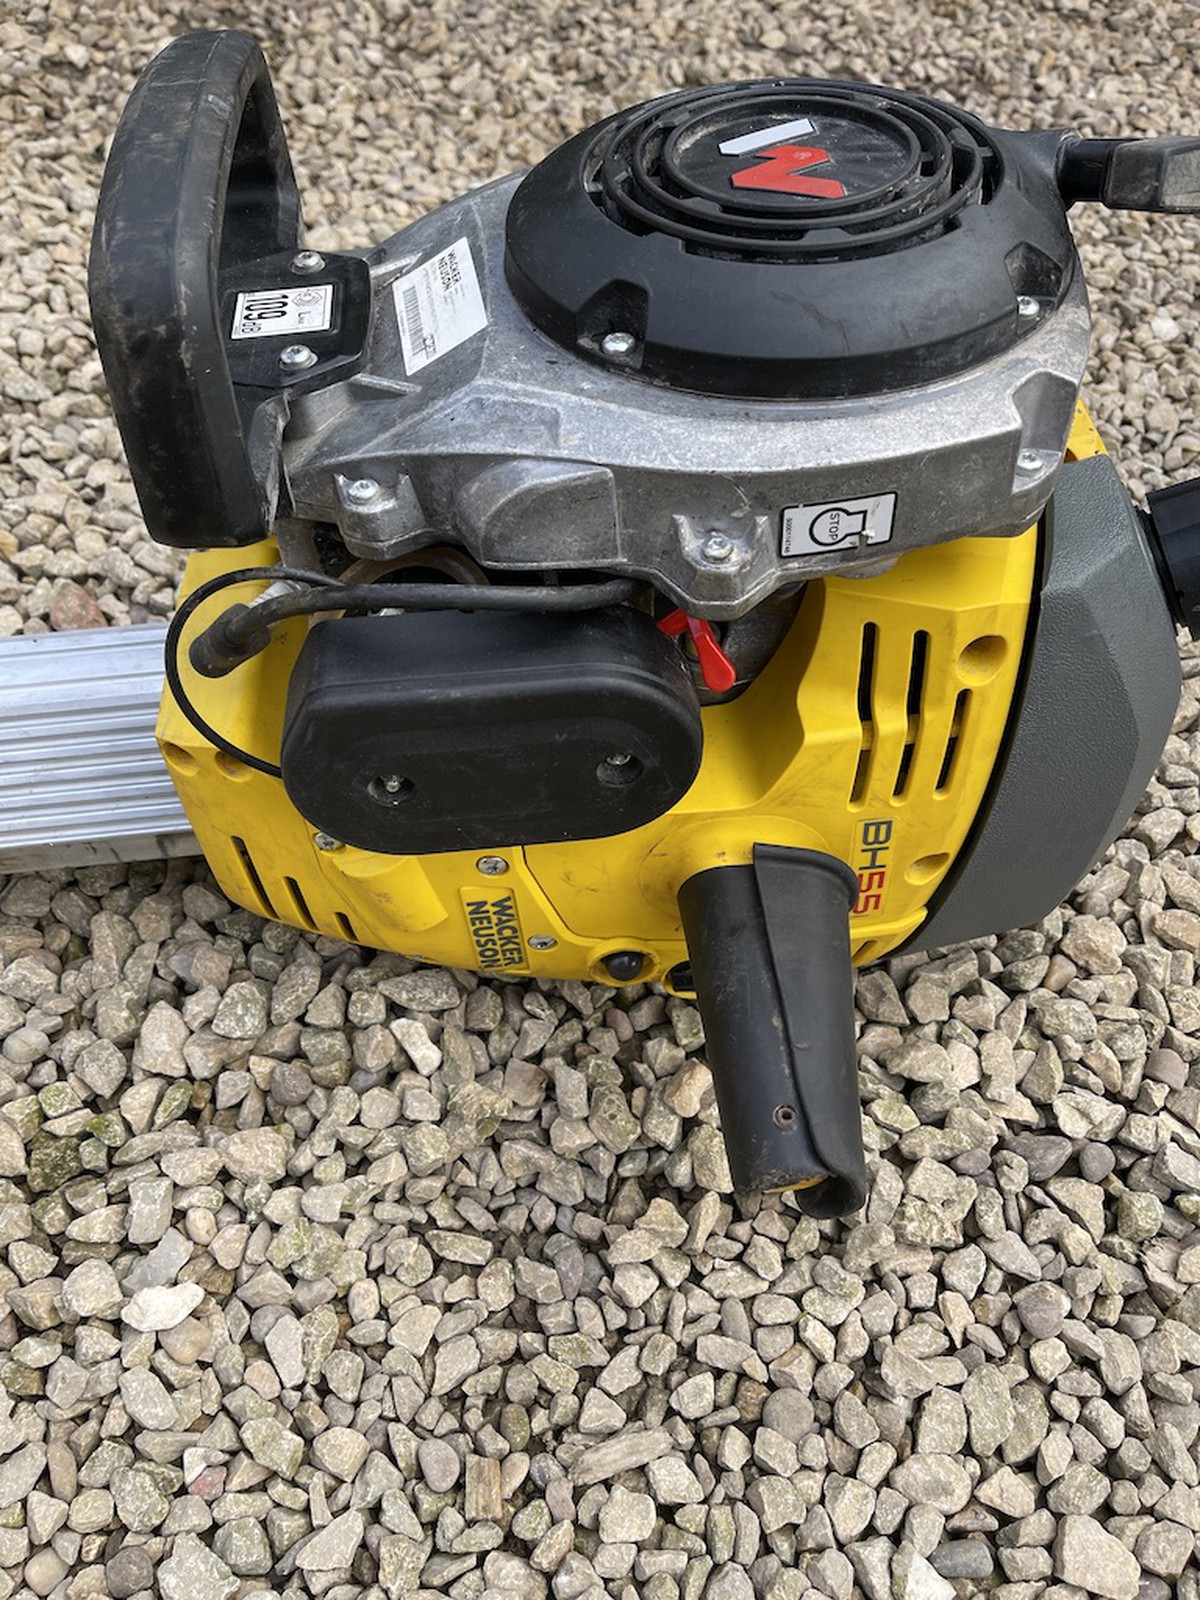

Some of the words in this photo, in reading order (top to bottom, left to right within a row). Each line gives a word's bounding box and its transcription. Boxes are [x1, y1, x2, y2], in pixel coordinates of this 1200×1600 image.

[437, 256, 452, 292] NEUSON
[447, 249, 462, 282] WACKER
[243, 294, 289, 321] 109
[241, 321, 262, 334] dB
[828, 512, 841, 541] STOP
[852, 820, 893, 914] BH55
[466, 900, 502, 969] NEUSON
[490, 895, 524, 967] WACKER
